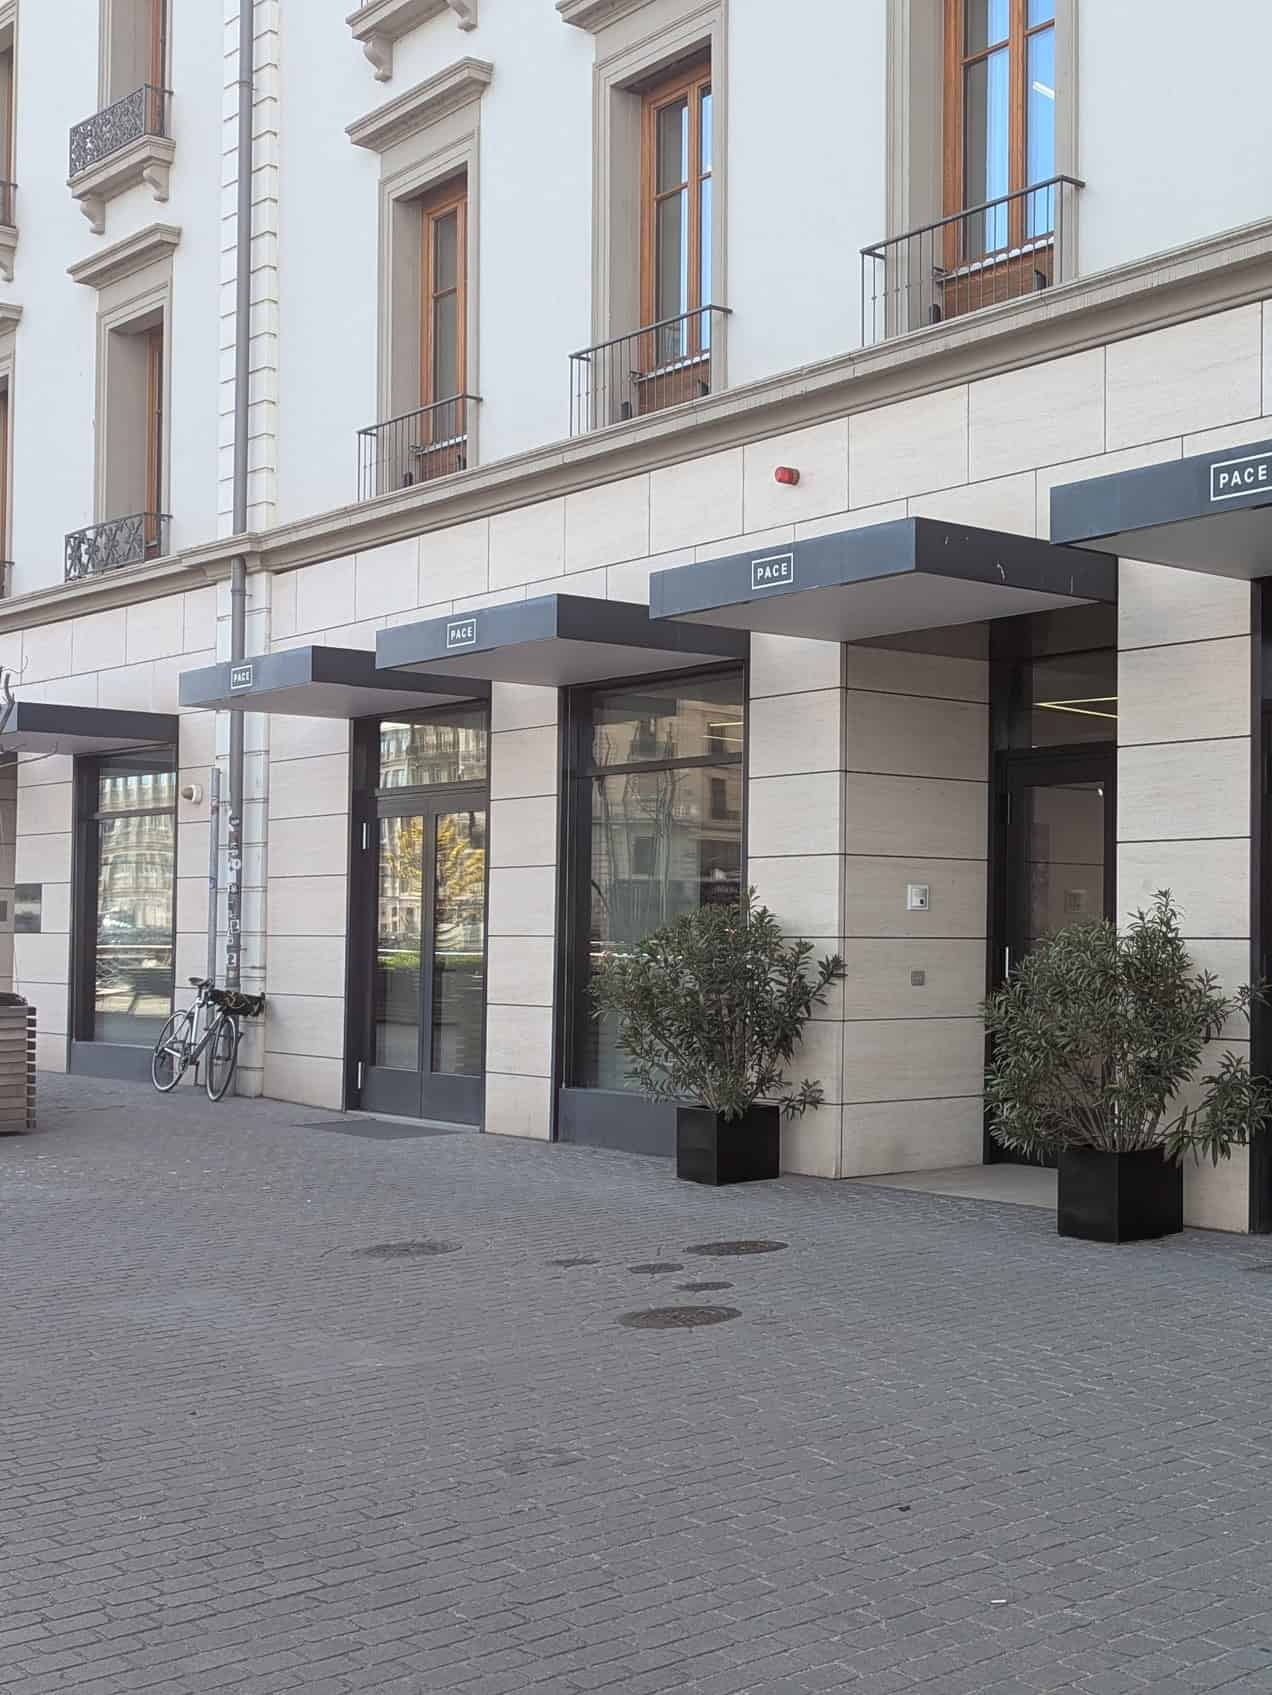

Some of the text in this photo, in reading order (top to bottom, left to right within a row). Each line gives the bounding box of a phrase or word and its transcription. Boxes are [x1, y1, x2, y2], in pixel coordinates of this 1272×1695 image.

[1219, 464, 1268, 489] PACE
[757, 562, 788, 581] PACE
[450, 626, 473, 641] PACE
